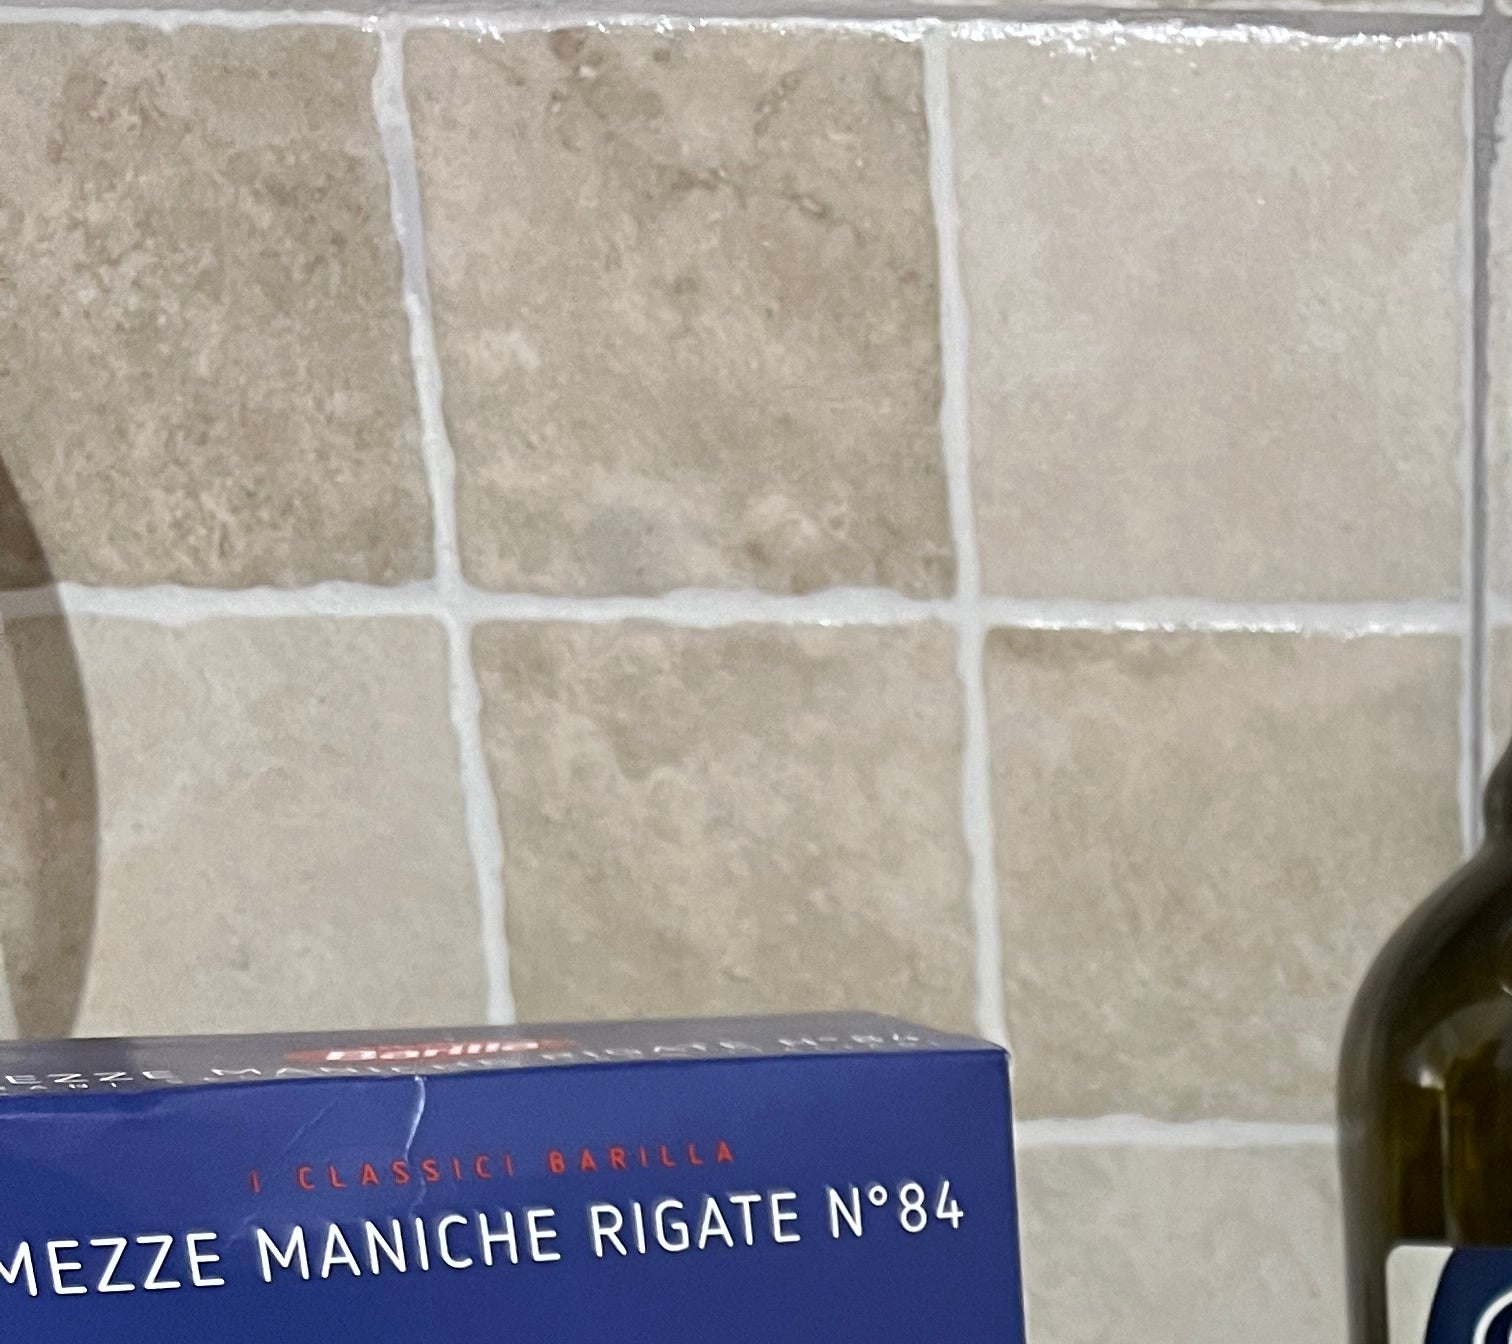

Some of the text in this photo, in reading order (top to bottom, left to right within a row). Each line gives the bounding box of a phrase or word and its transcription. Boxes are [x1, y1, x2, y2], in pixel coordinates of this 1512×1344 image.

[250, 1140, 734, 1193] I CLASSICI BARILLA
[256, 1209, 561, 1283] MANICHE
[589, 1191, 801, 1258] RIGATE
[828, 1180, 965, 1239] N°84
